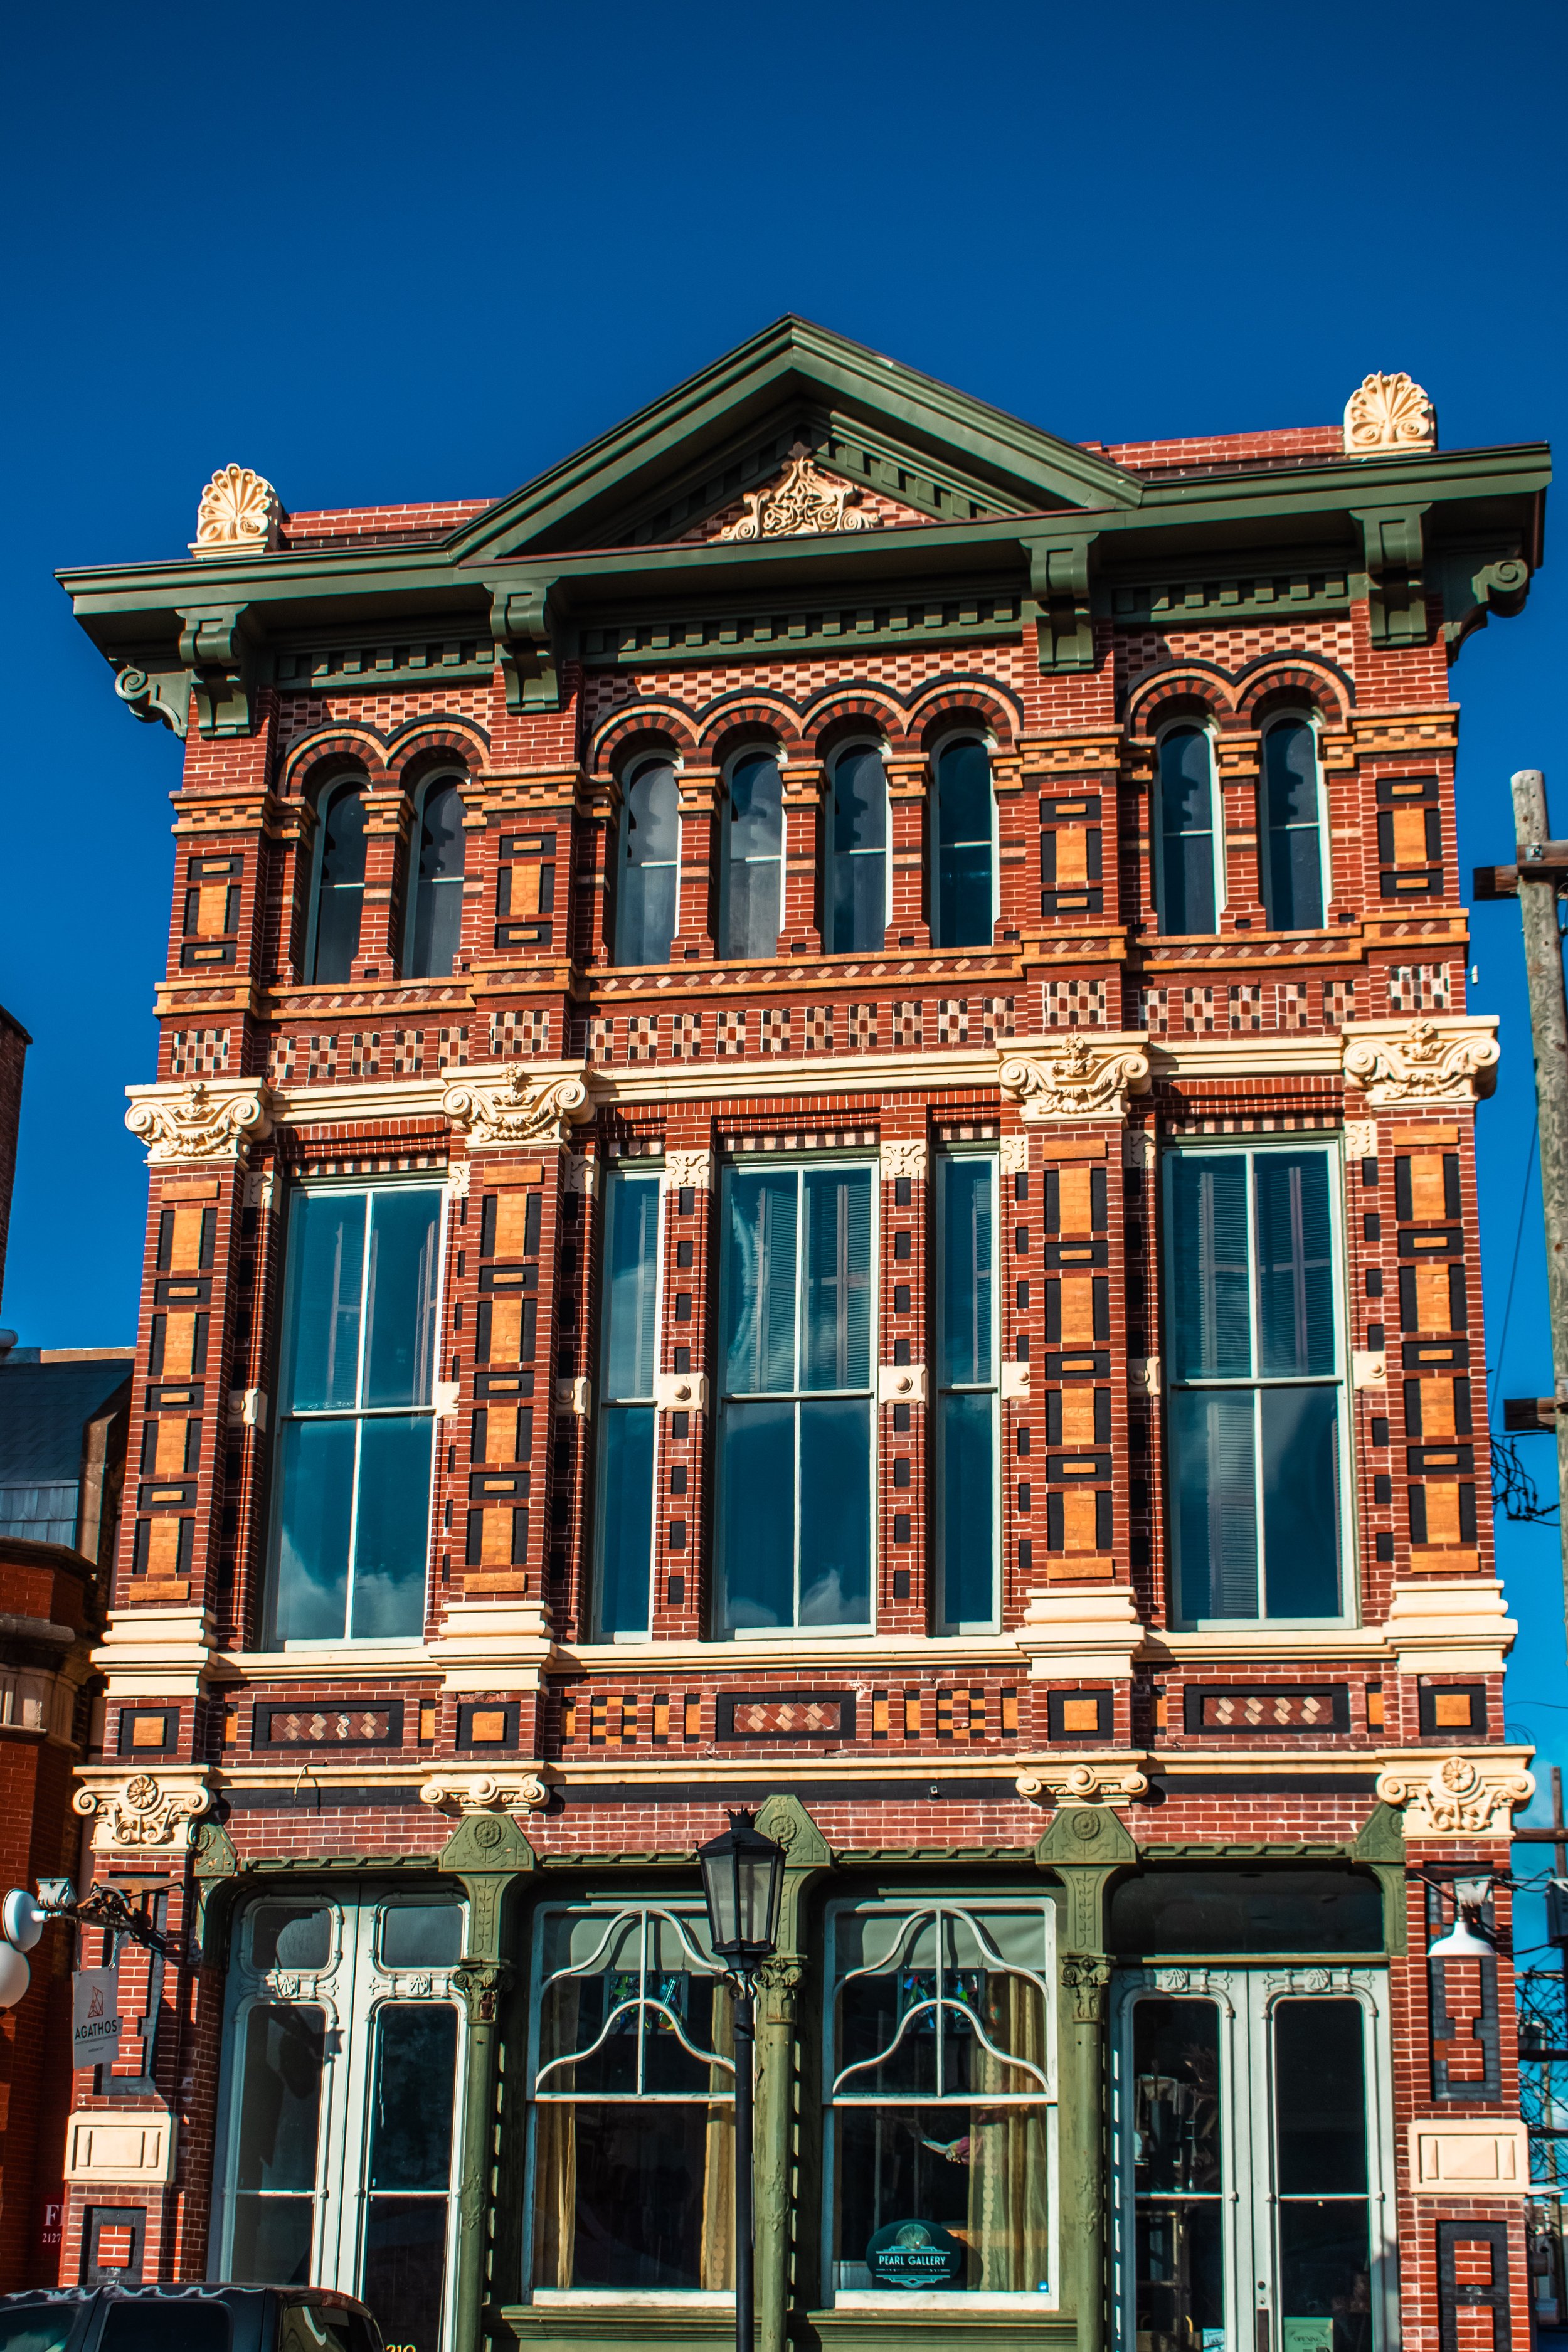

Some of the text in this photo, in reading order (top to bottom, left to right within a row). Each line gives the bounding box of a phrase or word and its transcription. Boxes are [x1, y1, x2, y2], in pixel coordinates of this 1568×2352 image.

[75, 2020, 117, 2040] AGATHOS
[42, 2233, 61, 2243] 2127
[879, 2255, 946, 2265] PEARL GALLERY
